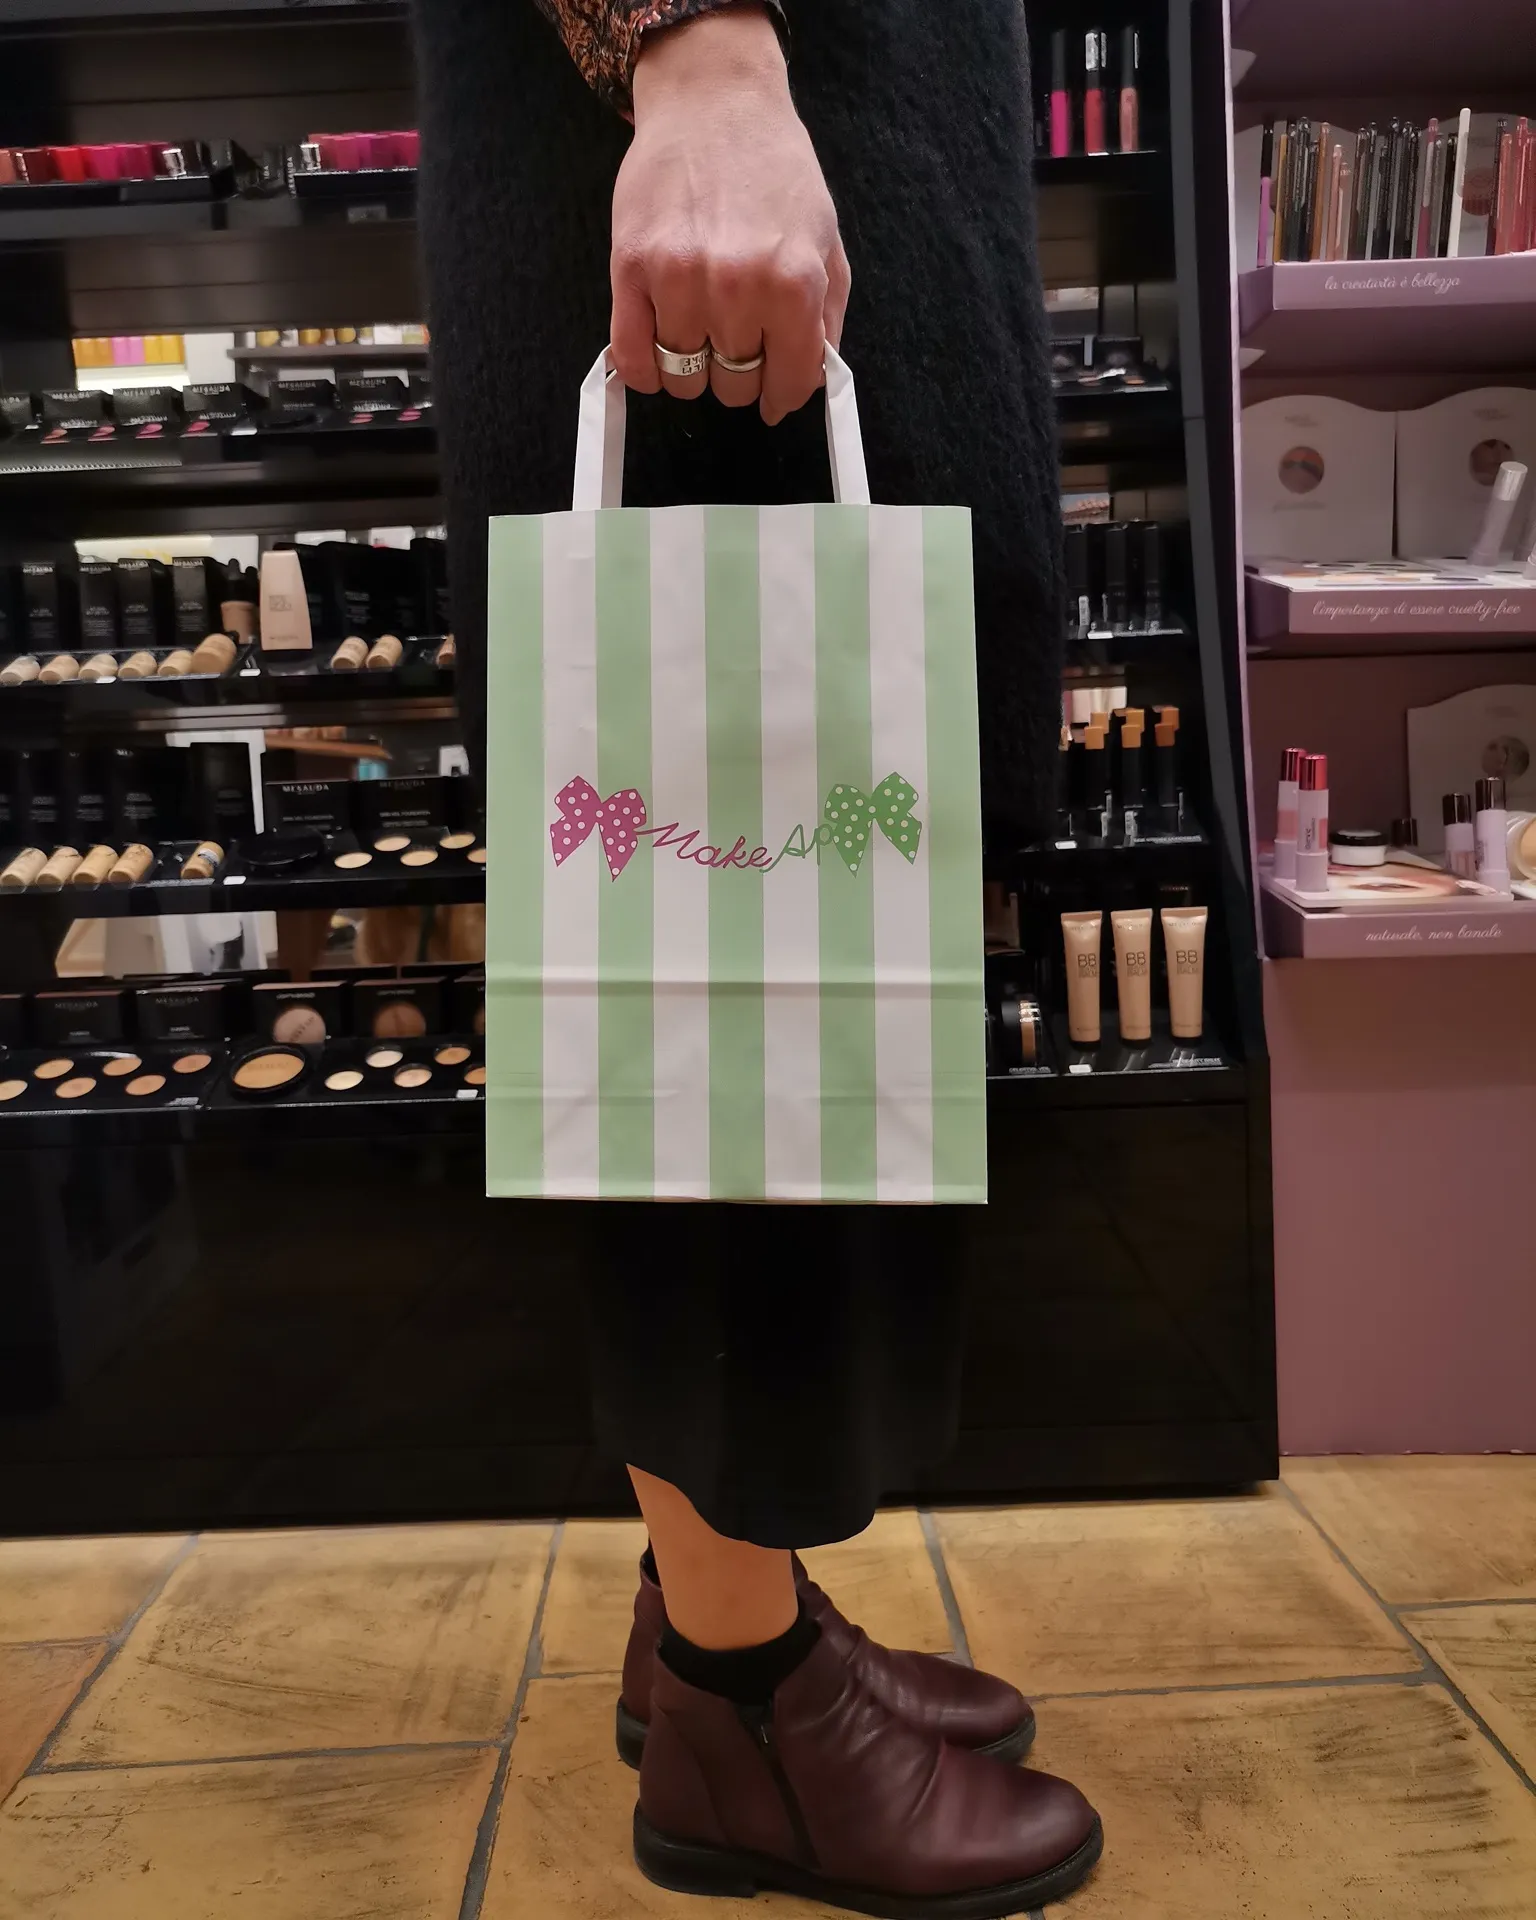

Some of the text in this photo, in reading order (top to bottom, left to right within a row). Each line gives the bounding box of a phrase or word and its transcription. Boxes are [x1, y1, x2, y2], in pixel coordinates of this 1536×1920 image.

[1324, 275, 1338, 290] la
[1411, 272, 1461, 295] bellezza
[1393, 601, 1407, 615] di
[1409, 604, 1445, 616] essere
[1448, 598, 1522, 622] cruelty-free
[1428, 930, 1454, 940] non
[1457, 922, 1503, 939] banale
[1077, 953, 1098, 968] BB
[1125, 951, 1147, 966] BB
[1175, 950, 1199, 965] BB
